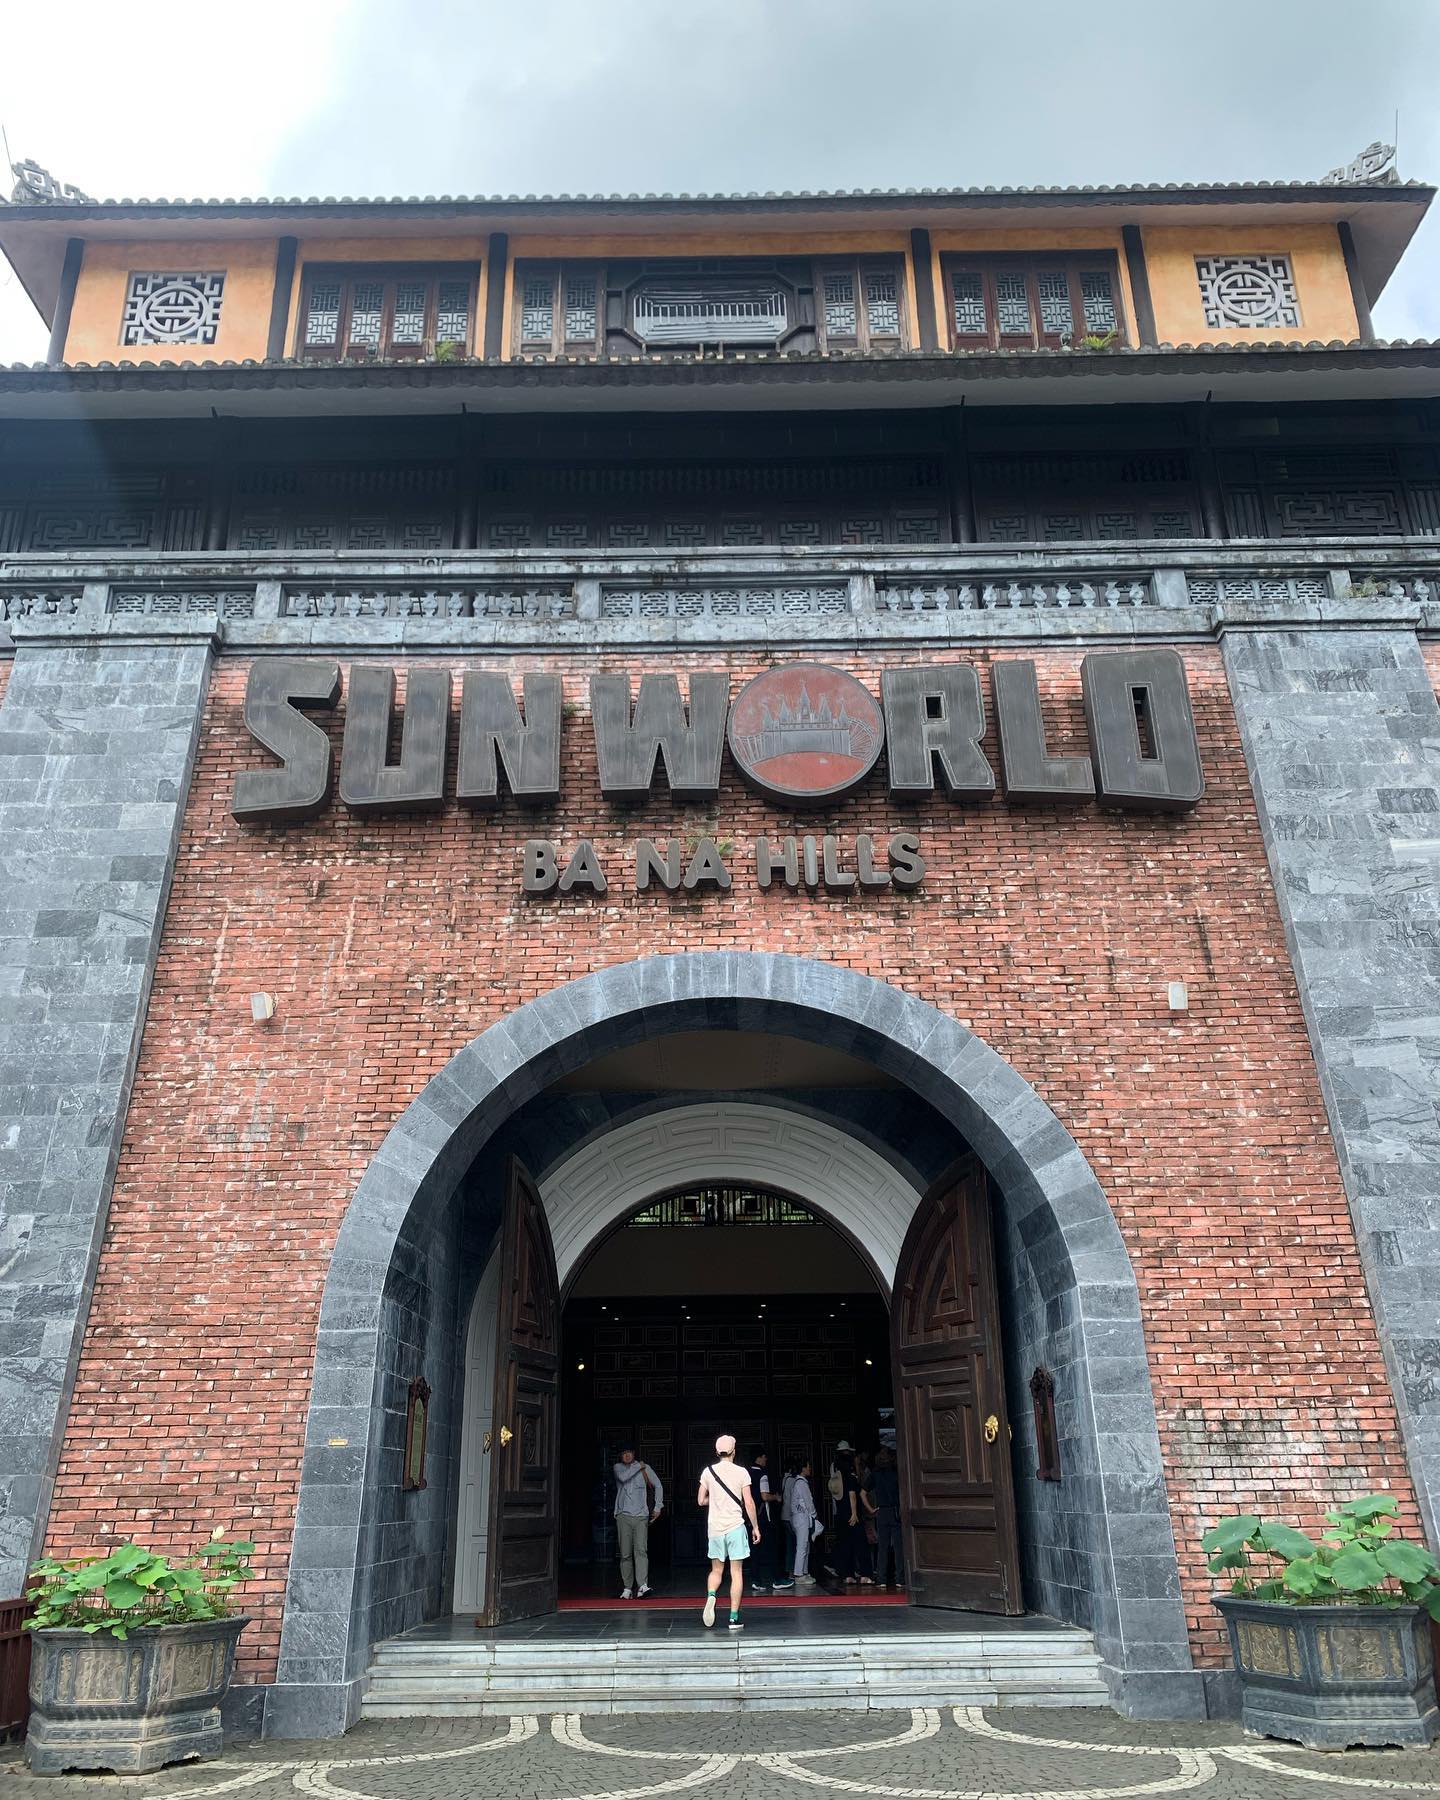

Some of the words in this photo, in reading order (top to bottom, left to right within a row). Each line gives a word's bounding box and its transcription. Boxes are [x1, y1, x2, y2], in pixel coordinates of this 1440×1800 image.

[232, 657, 562, 824] SUN
[590, 648, 1206, 811] WORLD
[523, 838, 608, 896] BA
[636, 837, 732, 894] NA
[757, 832, 927, 891] HILLS
